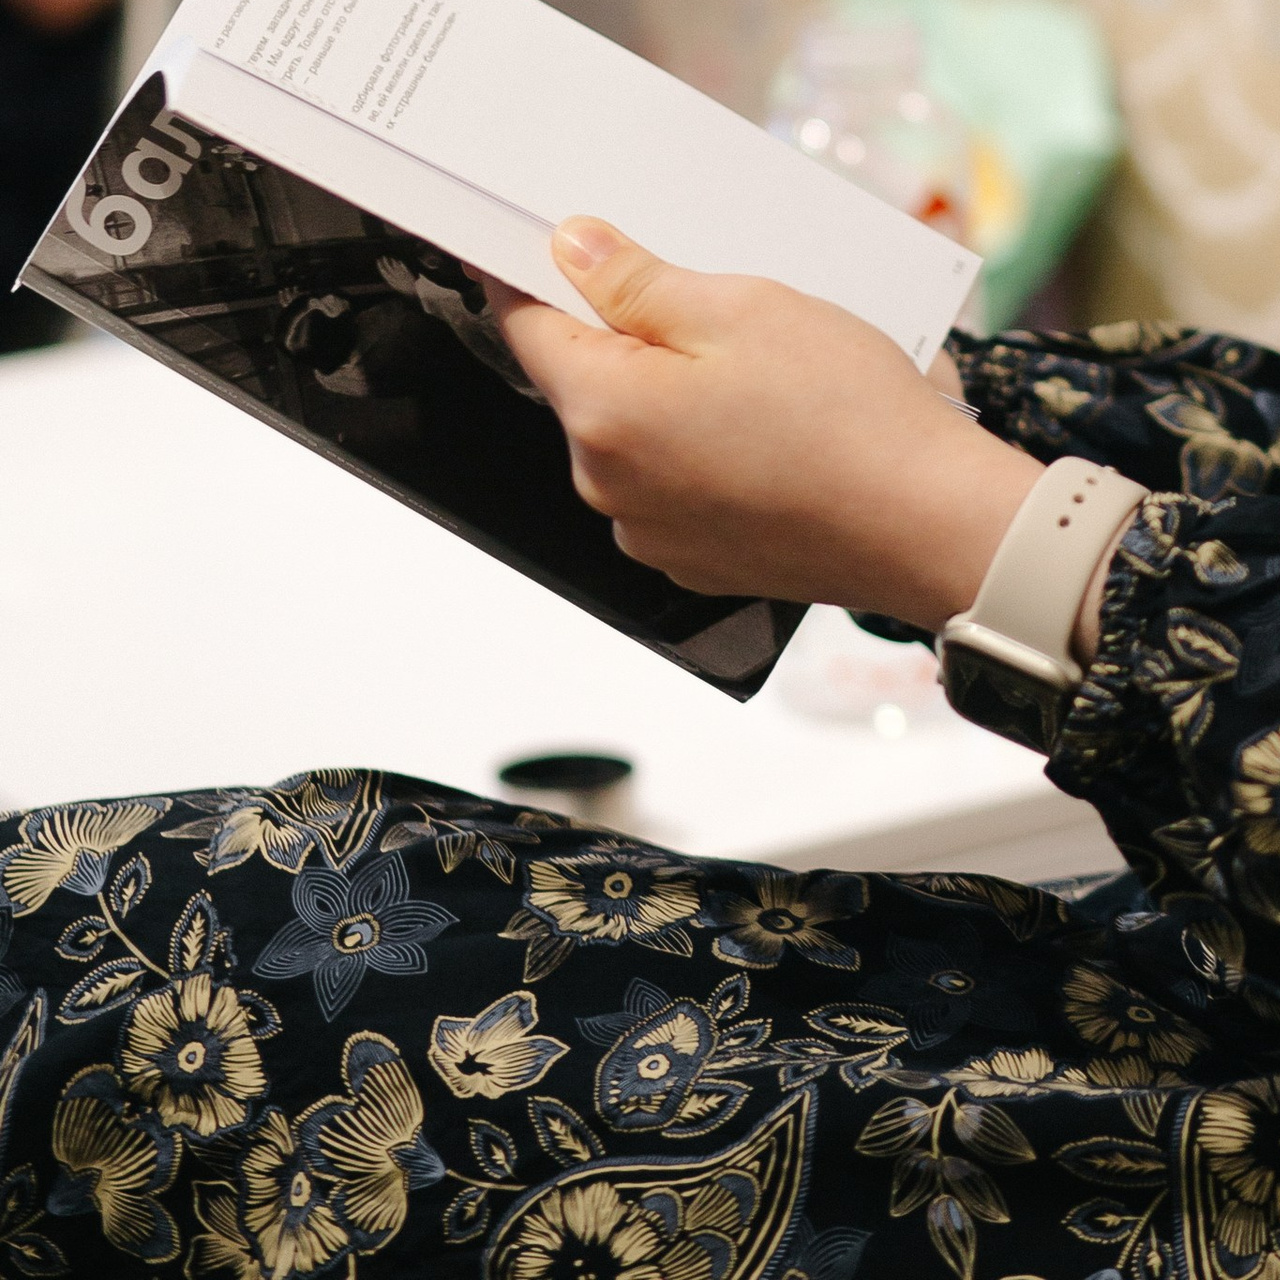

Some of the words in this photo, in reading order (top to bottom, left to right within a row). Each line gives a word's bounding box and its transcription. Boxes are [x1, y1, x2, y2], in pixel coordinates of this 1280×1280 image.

[214, 37, 225, 49] из
[266, 47, 284, 67] Мы
[279, 18, 302, 48] вдруг
[297, 17, 324, 51] Только
[307, 35, 337, 76] раньше
[331, 15, 347, 34] это
[378, 1, 421, 63] фотографии
[375, 92, 389, 108] ей
[384, 57, 410, 94] велели
[405, 18, 433, 58] сделать
